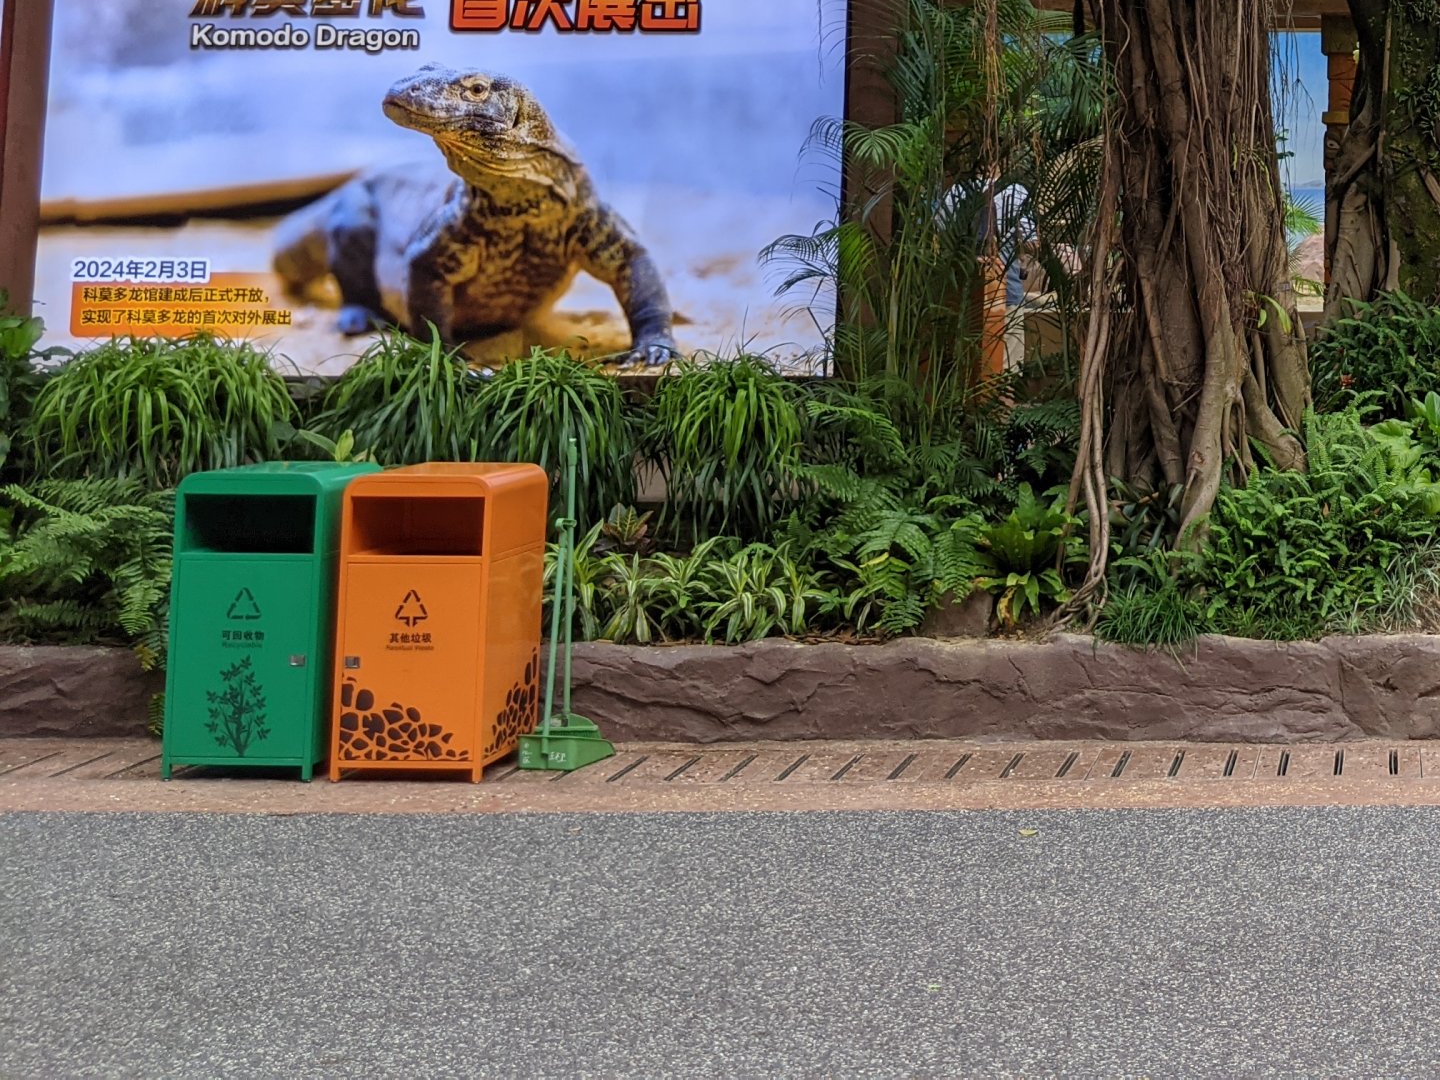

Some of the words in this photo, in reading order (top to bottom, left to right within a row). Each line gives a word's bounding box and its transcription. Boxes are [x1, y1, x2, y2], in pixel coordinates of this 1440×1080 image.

[191, 24, 310, 48] Komodo
[315, 24, 419, 51] Dragon
[73, 260, 207, 279] 2024年2月3日
[81, 309, 292, 325] 实现了科莫多龙的首次对外展出
[222, 630, 265, 641] 可回收物
[389, 633, 432, 643] 其他垃圾
